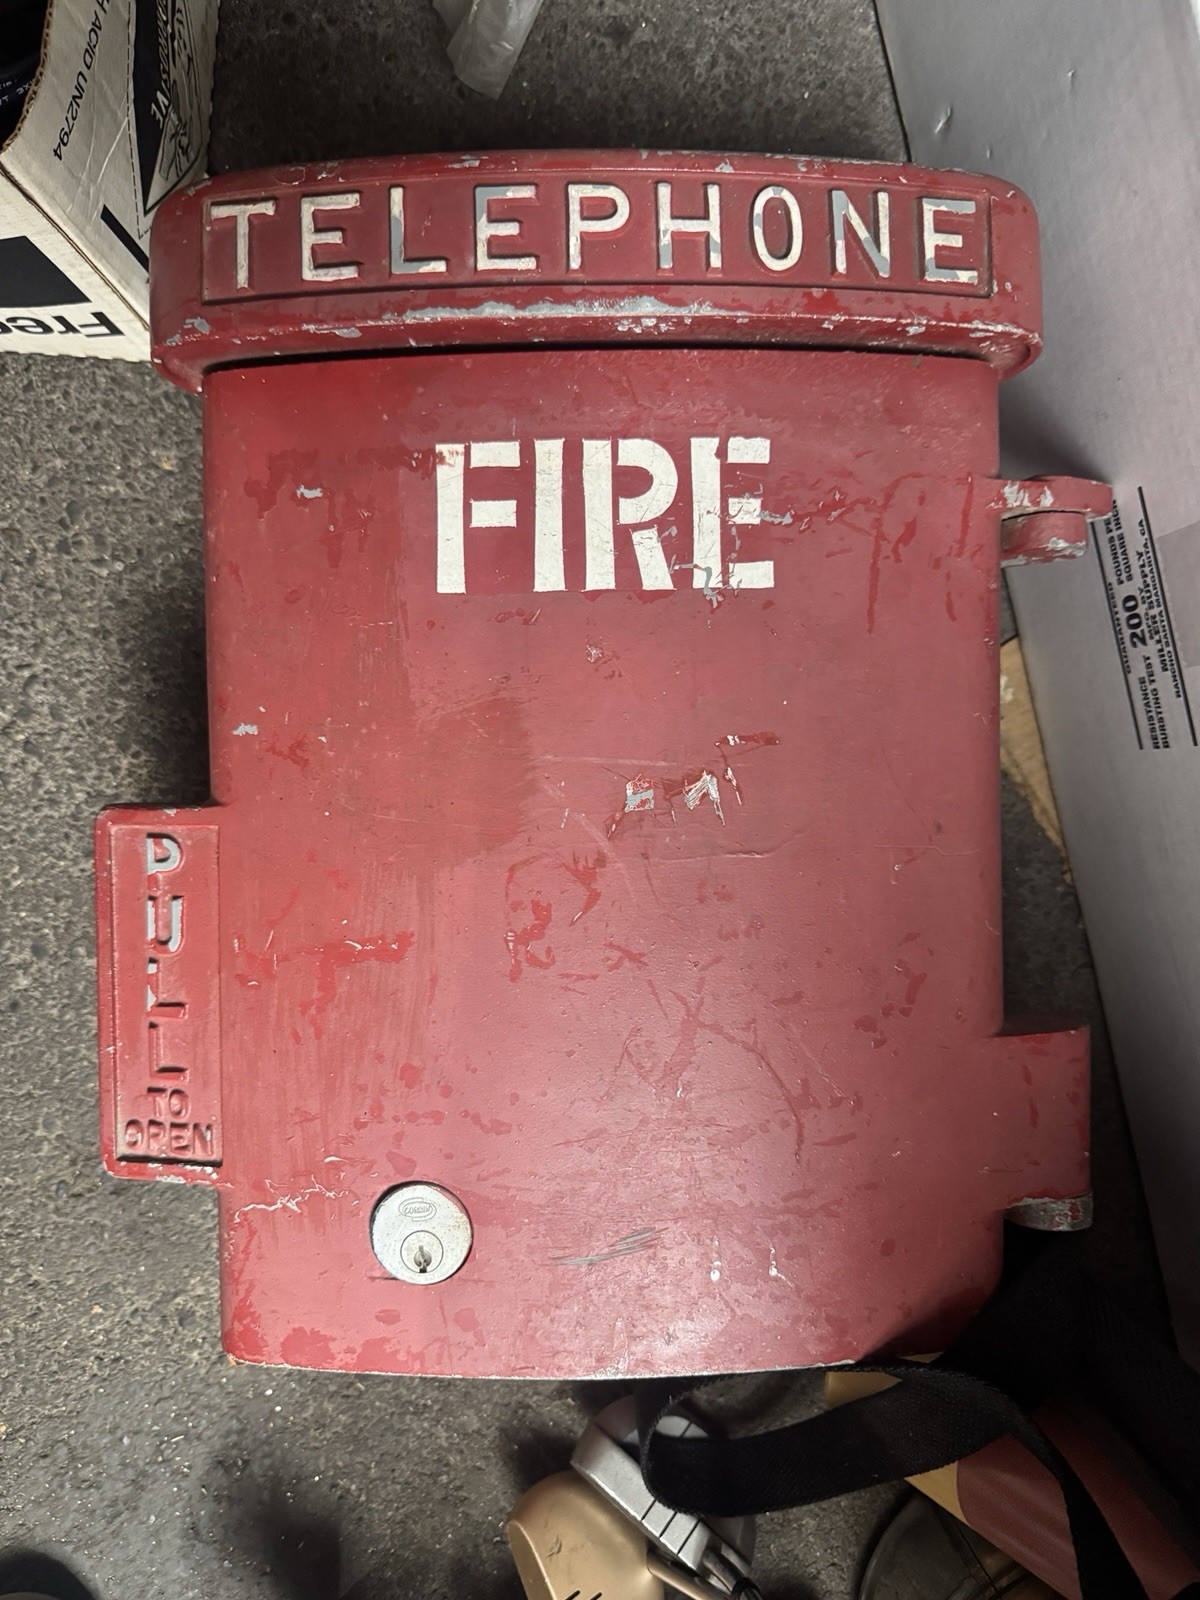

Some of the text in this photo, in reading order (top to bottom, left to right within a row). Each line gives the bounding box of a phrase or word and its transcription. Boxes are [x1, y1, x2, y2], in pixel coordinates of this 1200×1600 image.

[53, 10, 102, 161] ACID UN2794
[151, 0, 171, 129] ORROSIVE
[208, 182, 980, 290] TELEPHONE
[0, 311, 126, 338] Fre
[435, 436, 775, 594] FIRE
[1107, 536, 1124, 586] POUNDS
[1116, 532, 1133, 583] SQUARE
[1107, 581, 1132, 675] GUARANTEED
[1121, 594, 1147, 649] 200
[1136, 550, 1169, 673] MILLER SUPPLY
[1137, 519, 1182, 699] RANCHO SANTA MARGARITA, CA
[1138, 586, 1147, 605] BY
[1138, 676, 1161, 750] RESISTANCE
[1143, 655, 1170, 749] BURSTING TEST
[145, 831, 189, 1082] PULL
[122, 1119, 215, 1157] OPEN
[146, 1085, 191, 1121] TO
